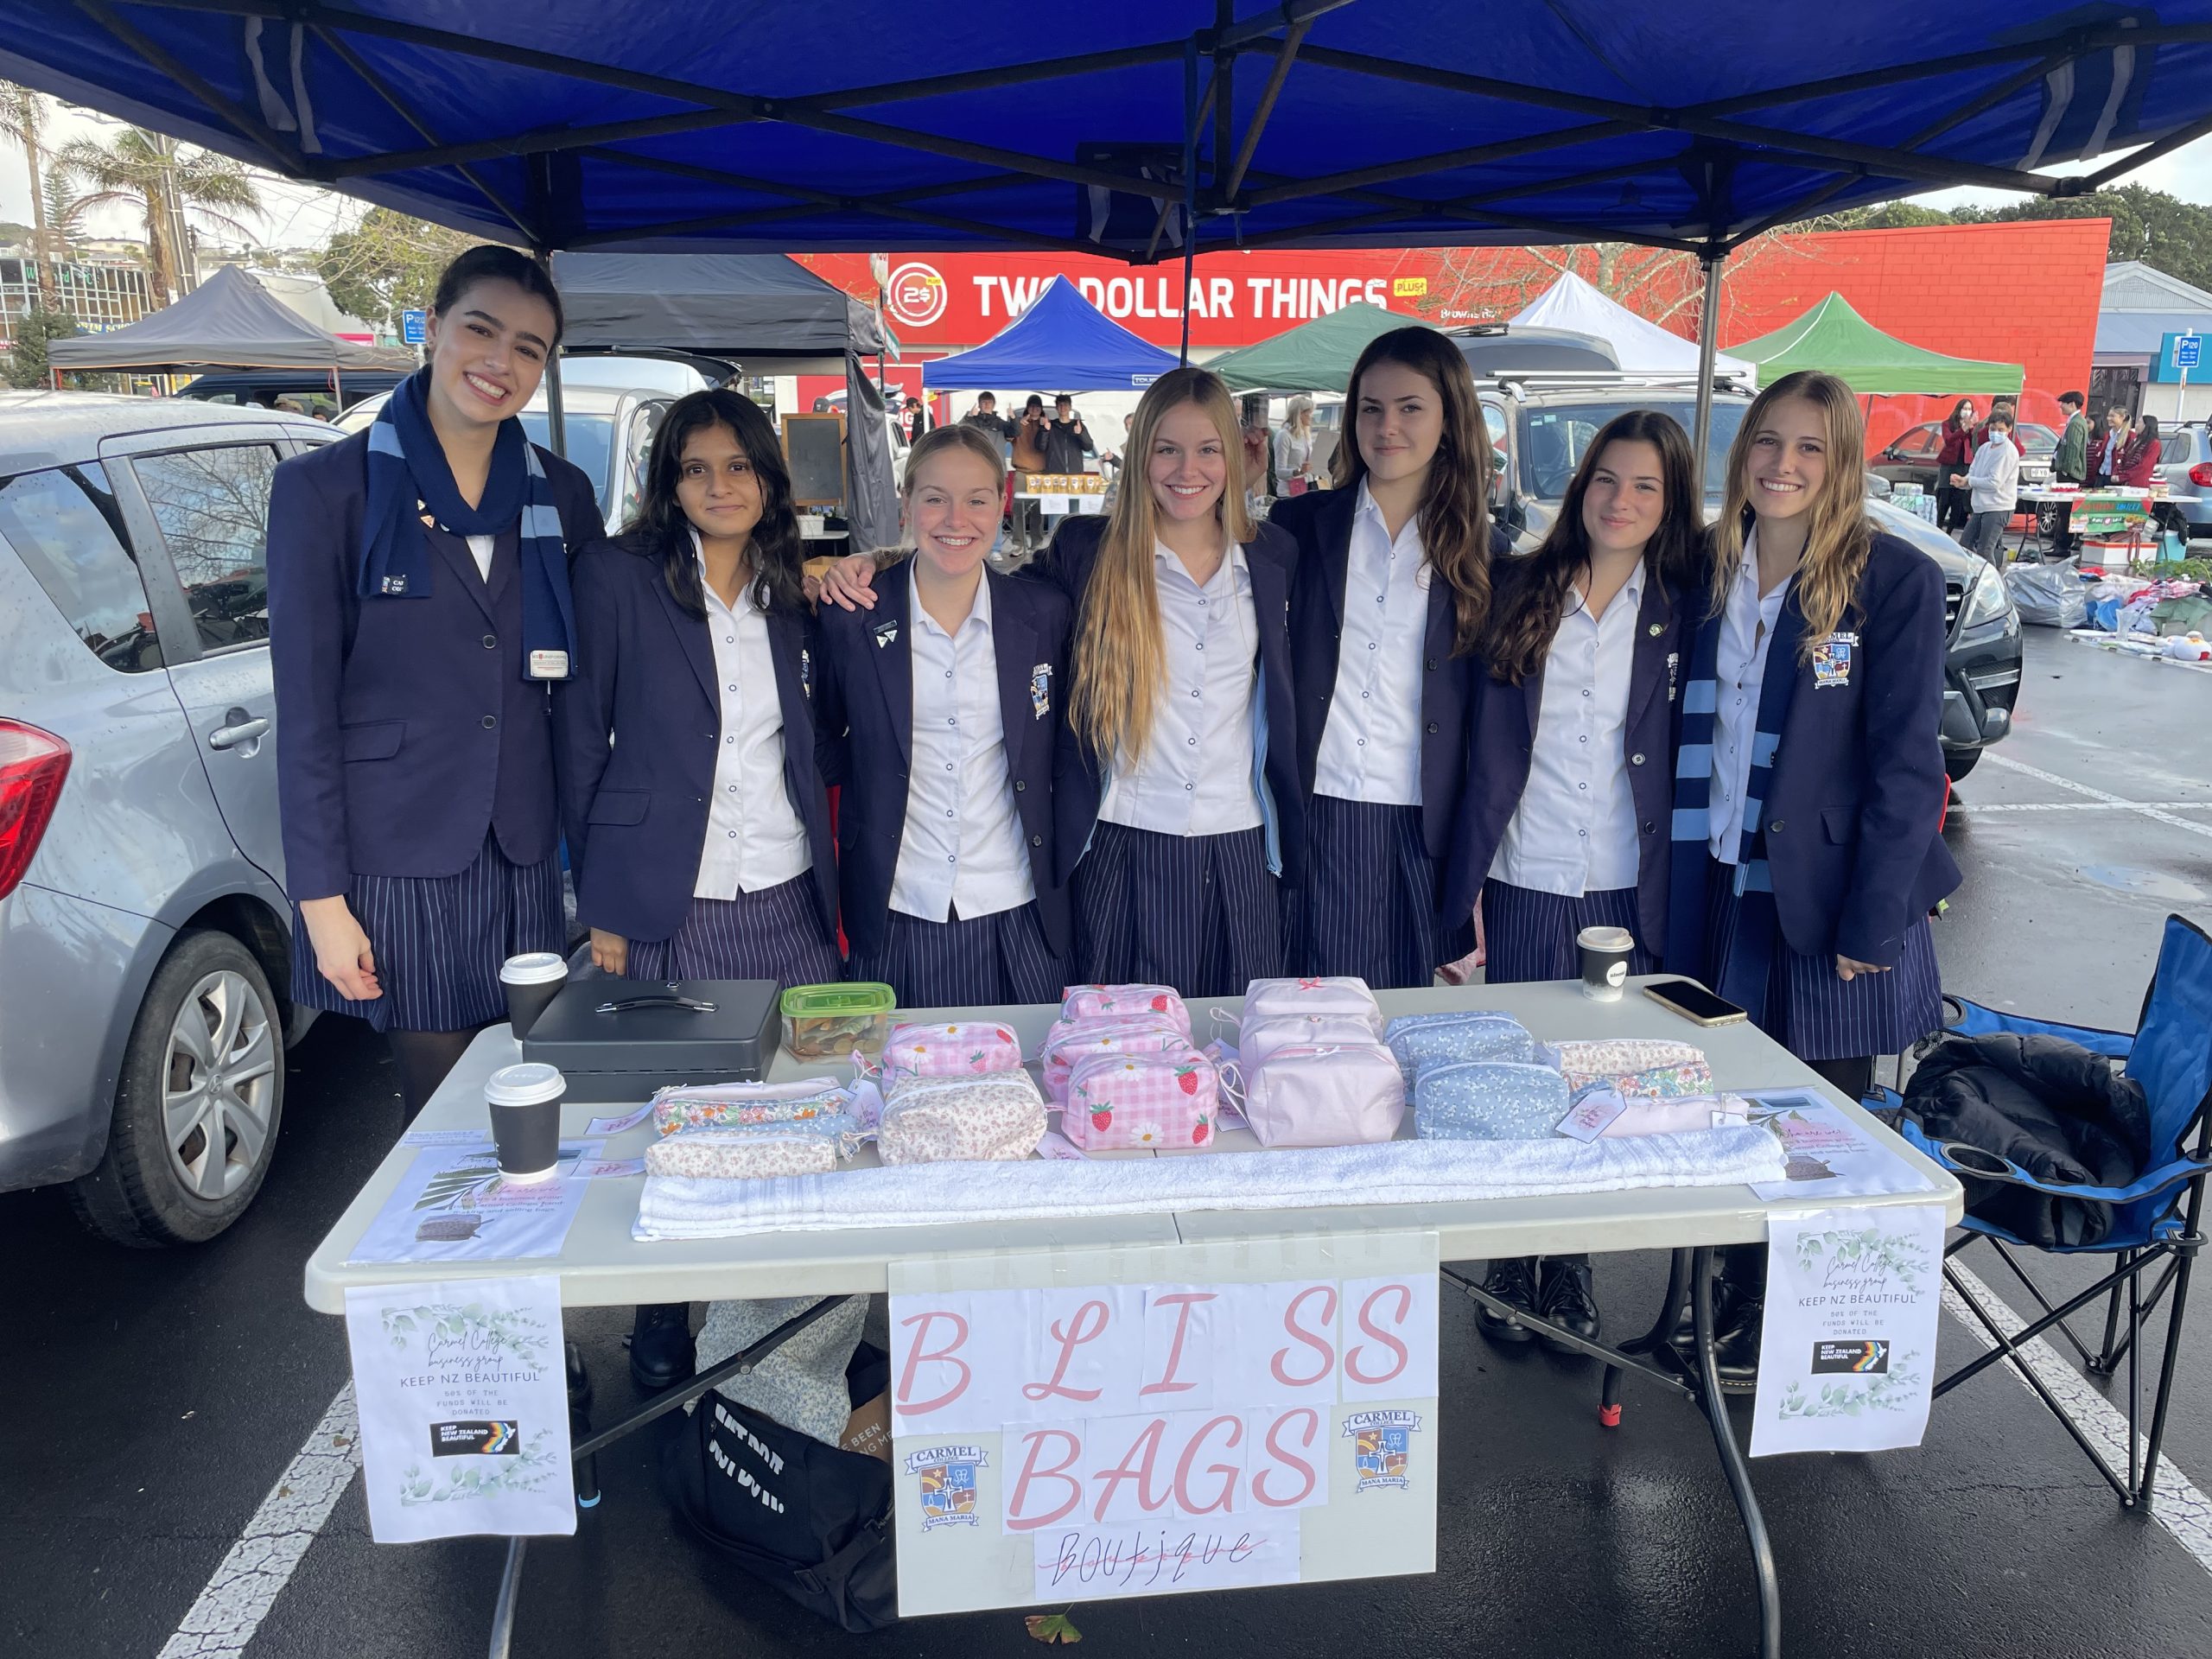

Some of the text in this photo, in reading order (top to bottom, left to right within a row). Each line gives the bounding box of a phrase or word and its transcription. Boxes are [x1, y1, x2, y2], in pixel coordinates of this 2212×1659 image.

[1079, 276, 1234, 318] DOLLAR
[1247, 277, 1388, 318] THINGS
[2182, 340, 2198, 349] P120
[1823, 1273, 1887, 1294] business group
[1799, 1294, 1916, 1306] KEEP NZ BEAUTIFUL
[895, 1284, 1412, 1416] BLISS
[429, 1351, 503, 1372] business group
[401, 1372, 539, 1388] KEEP NZ BEAUTIFUL
[1355, 1412, 1410, 1424] CARMEL
[851, 1422, 881, 1446] BEEN
[916, 1446, 976, 1462] CARMEL
[1006, 1407, 1319, 1531] BAGS
